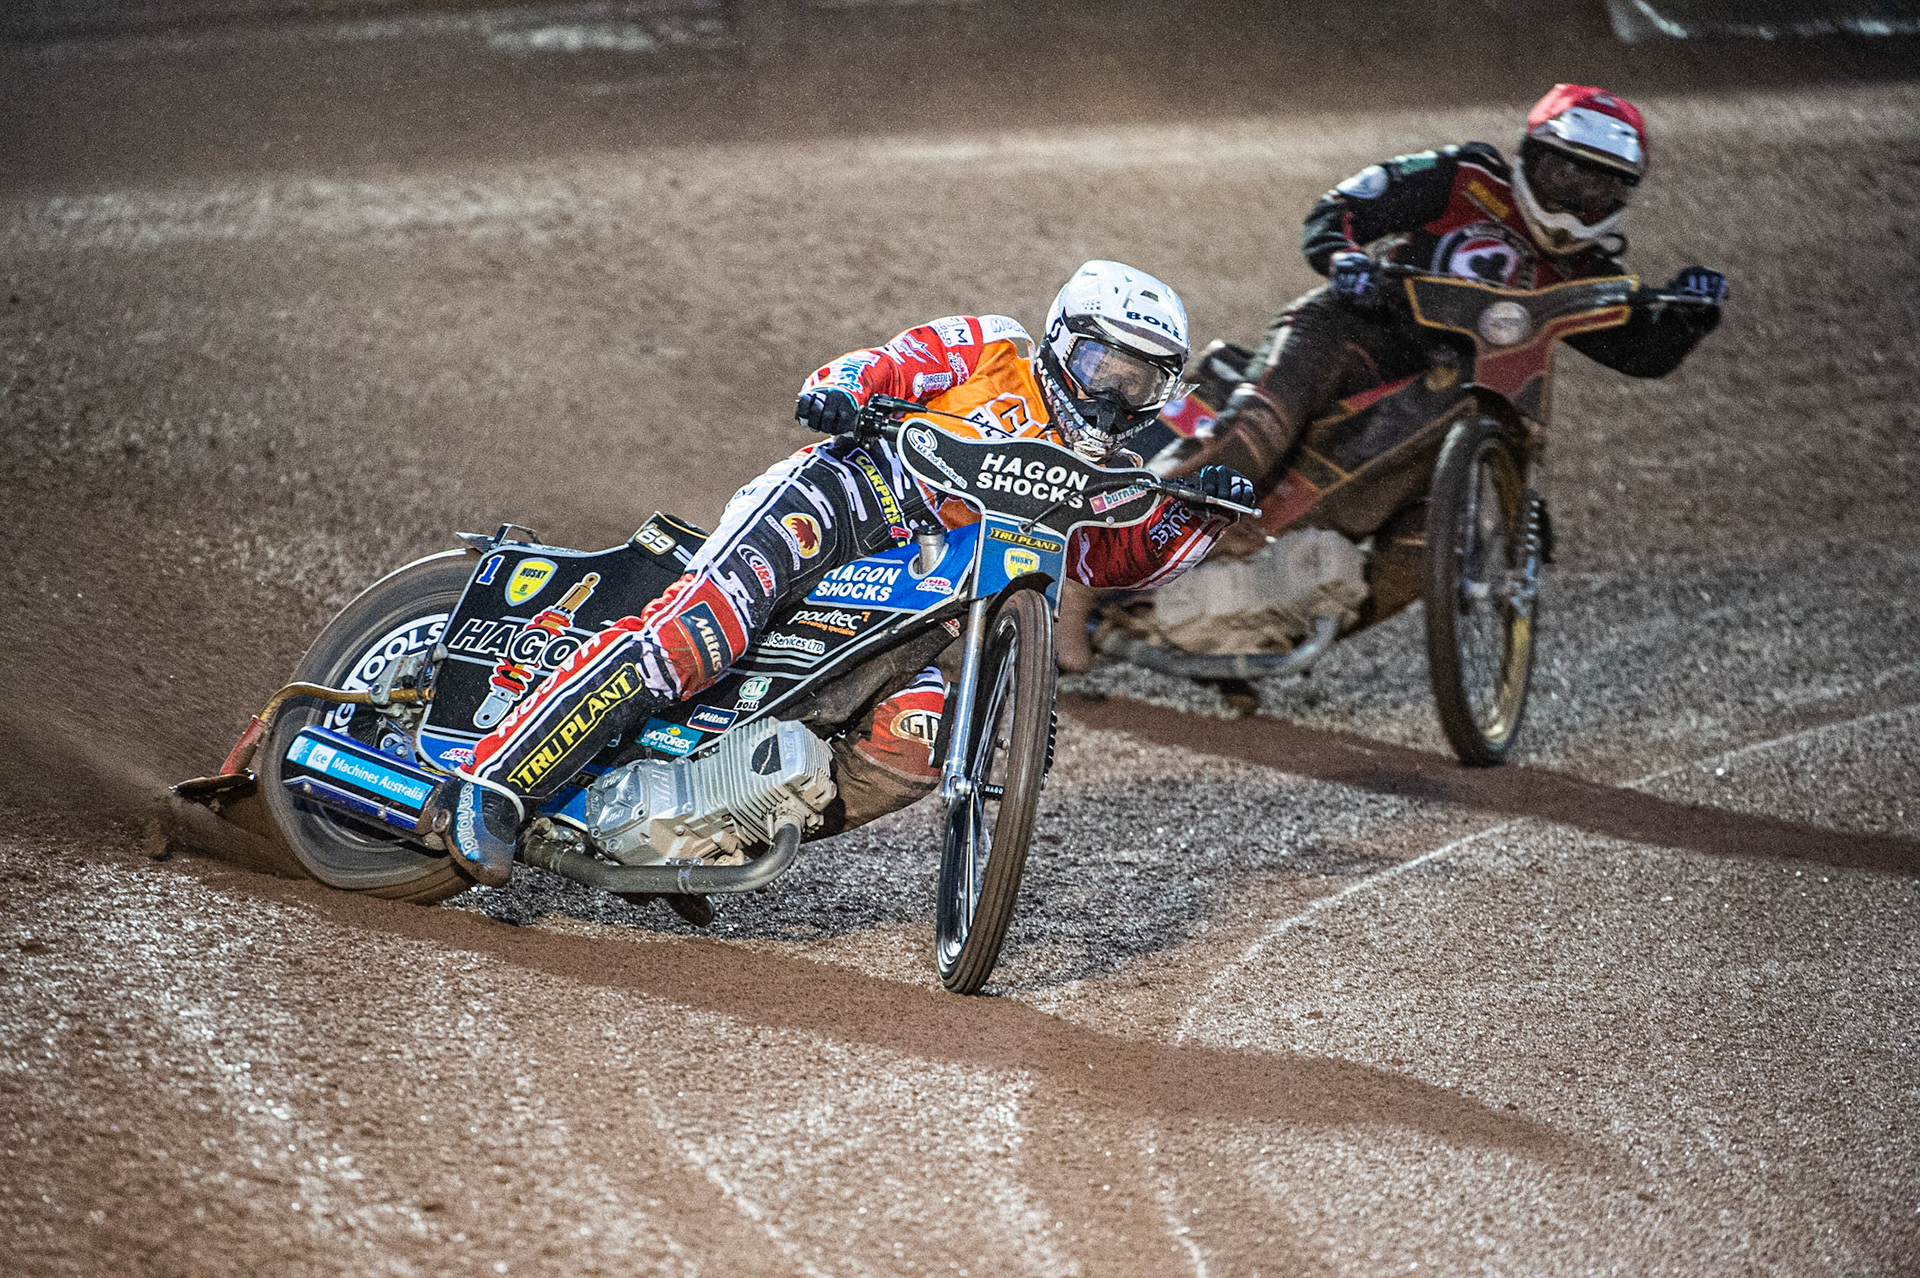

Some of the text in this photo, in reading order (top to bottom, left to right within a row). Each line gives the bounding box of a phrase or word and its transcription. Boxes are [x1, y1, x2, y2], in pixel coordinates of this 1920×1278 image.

[1126, 311, 1183, 341] BOLL
[980, 453, 1089, 491] HAGON
[856, 455, 900, 524] CARPETS
[976, 472, 1084, 509] SHOCKS
[635, 522, 676, 555] 69
[993, 529, 1059, 551] TRU PLANT
[476, 554, 505, 585] 1
[519, 567, 549, 579] HUSKY
[1010, 554, 1034, 566] HUSKY
[752, 563, 774, 590] J&B
[815, 581, 893, 602] SHOCKS
[787, 609, 862, 630] poultec
[447, 618, 583, 669] HAGO
[690, 615, 722, 672] Mitas
[773, 634, 806, 648] Services
[694, 712, 730, 725] Mitas
[738, 701, 758, 710] BOLL
[517, 671, 631, 785] TRU PLANT
[644, 729, 695, 749] MOTOREX
[311, 749, 424, 801] Ice Machines Australia
